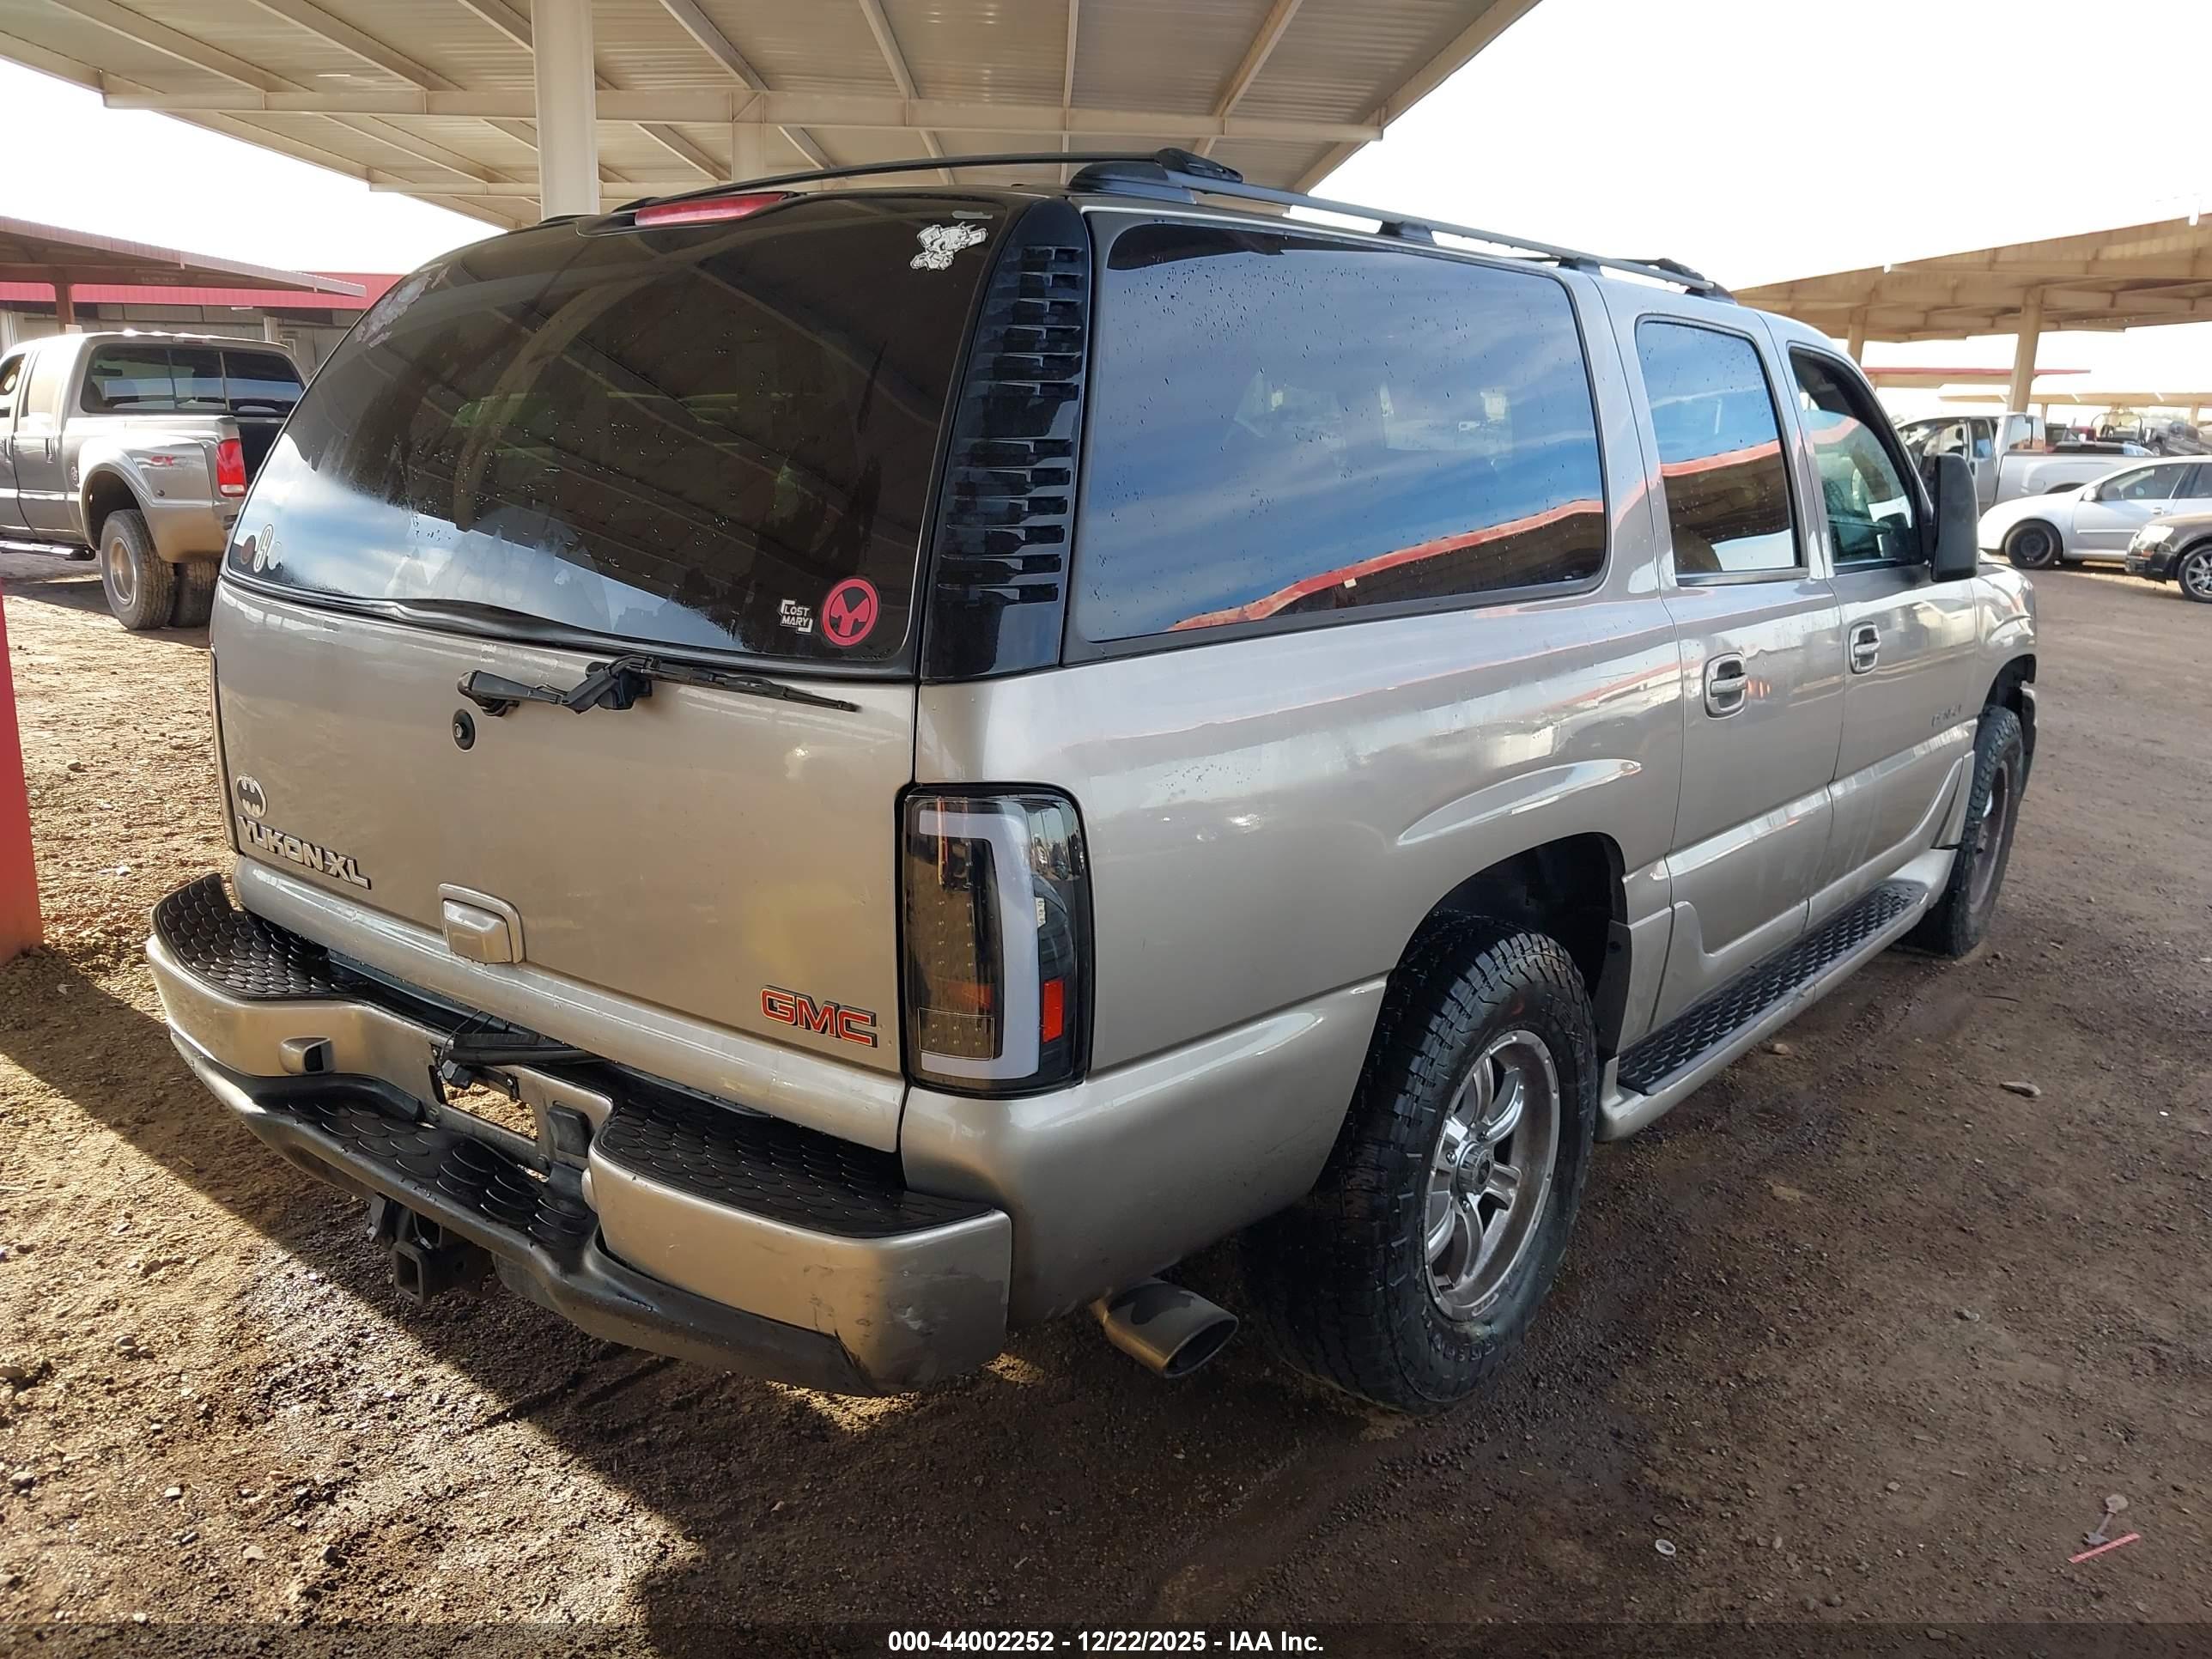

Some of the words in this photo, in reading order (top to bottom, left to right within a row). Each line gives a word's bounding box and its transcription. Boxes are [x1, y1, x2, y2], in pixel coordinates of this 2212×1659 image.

[781, 615, 809, 627] MARY
[784, 605, 810, 617] LOST
[238, 815, 324, 872] YUKON
[325, 850, 372, 890] XL
[760, 985, 878, 1048] GMC
